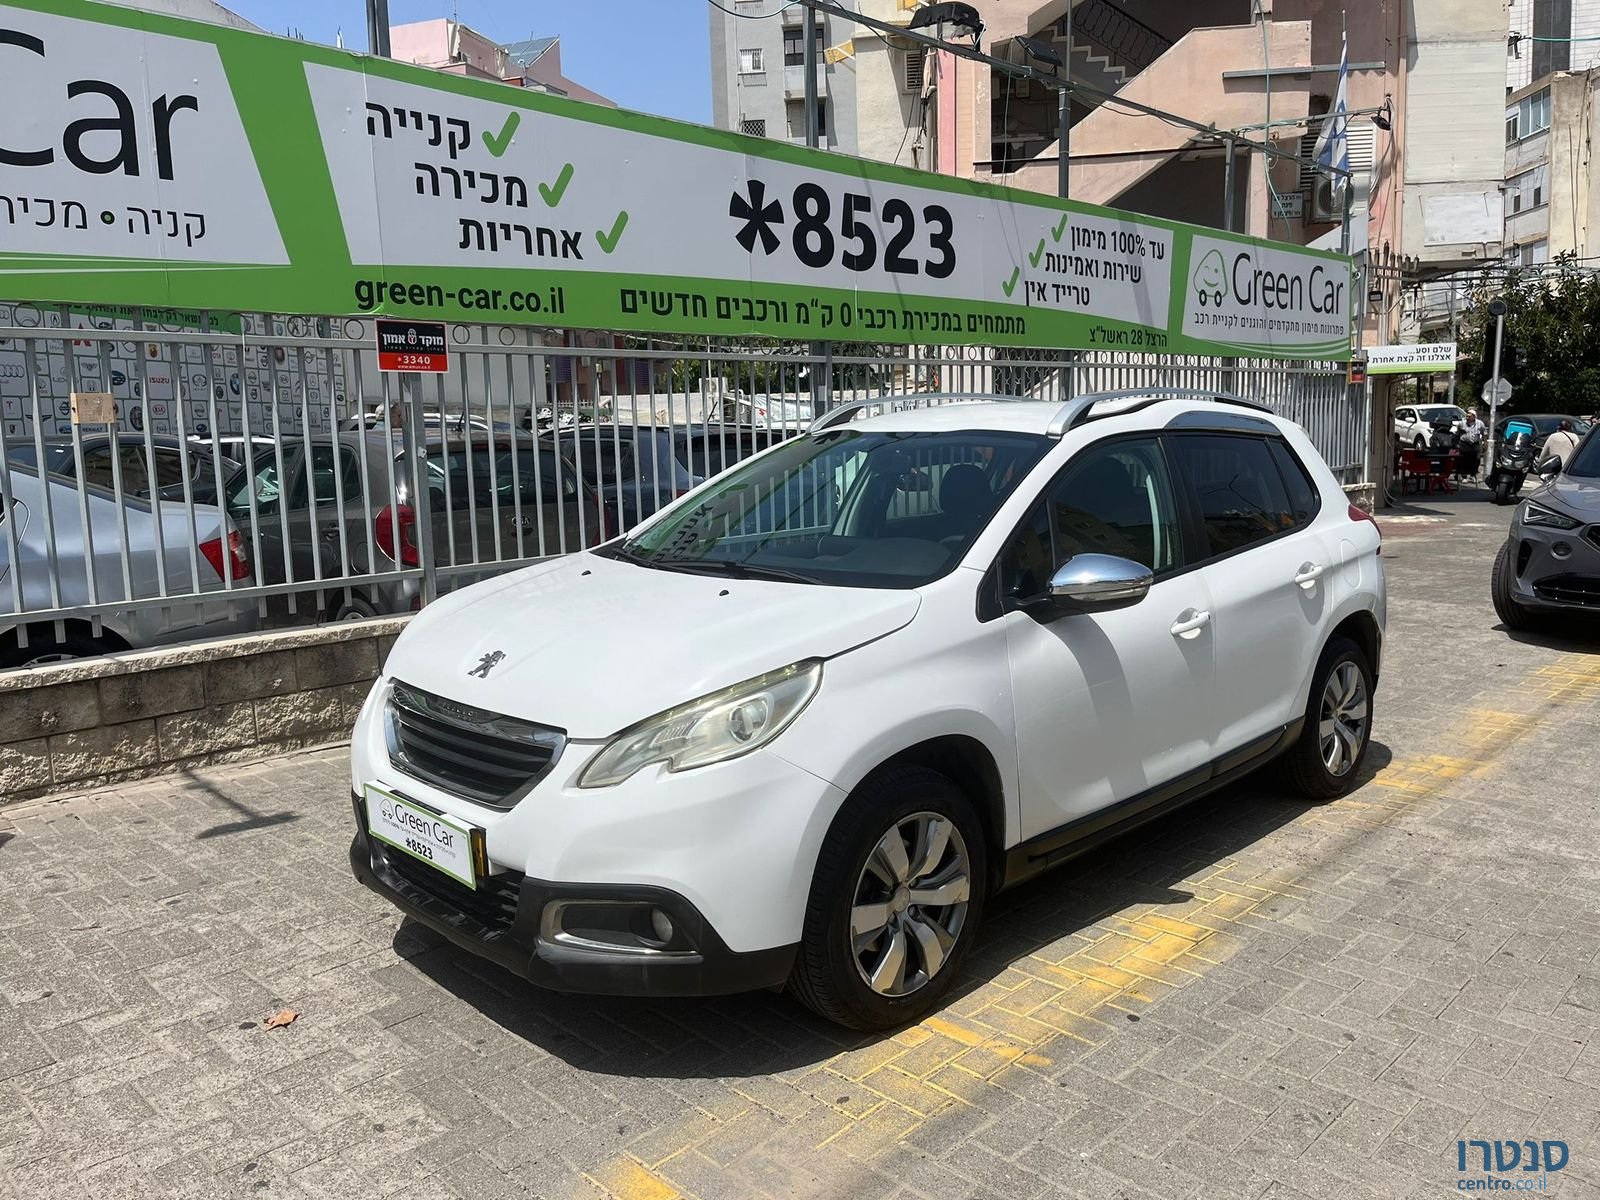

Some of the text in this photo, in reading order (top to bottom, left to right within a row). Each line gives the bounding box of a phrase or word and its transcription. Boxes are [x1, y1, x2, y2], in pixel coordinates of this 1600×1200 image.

[365, 101, 471, 160] קנייה
[414, 162, 529, 208] מכירה
[126, 206, 206, 248] קניה
[458, 217, 584, 260] אחריות
[1070, 226, 1165, 260] עד 100% מימון
[1045, 252, 1142, 284] שירות ואמינות
[354, 279, 565, 314] green-car.co.il
[1024, 280, 1090, 307] טרייד אין
[1232, 252, 1344, 315] Green Car
[619, 288, 707, 318] חדשים
[716, 294, 788, 323] ורכבים
[839, 301, 852, 328] 0
[857, 306, 897, 331] רכבי
[902, 309, 962, 334] במכירת
[966, 313, 1026, 336] מתמחים
[1194, 312, 1210, 325] רכב
[1212, 313, 1238, 330] לקניית
[1268, 319, 1300, 334] מתקדמים
[382, 333, 444, 347] מוקד אמון
[1131, 329, 1143, 346] 28
[1145, 329, 1168, 348] הרצל
[1432, 345, 1452, 354] שלם
[394, 803, 432, 838] Green
[432, 822, 454, 848] Car
